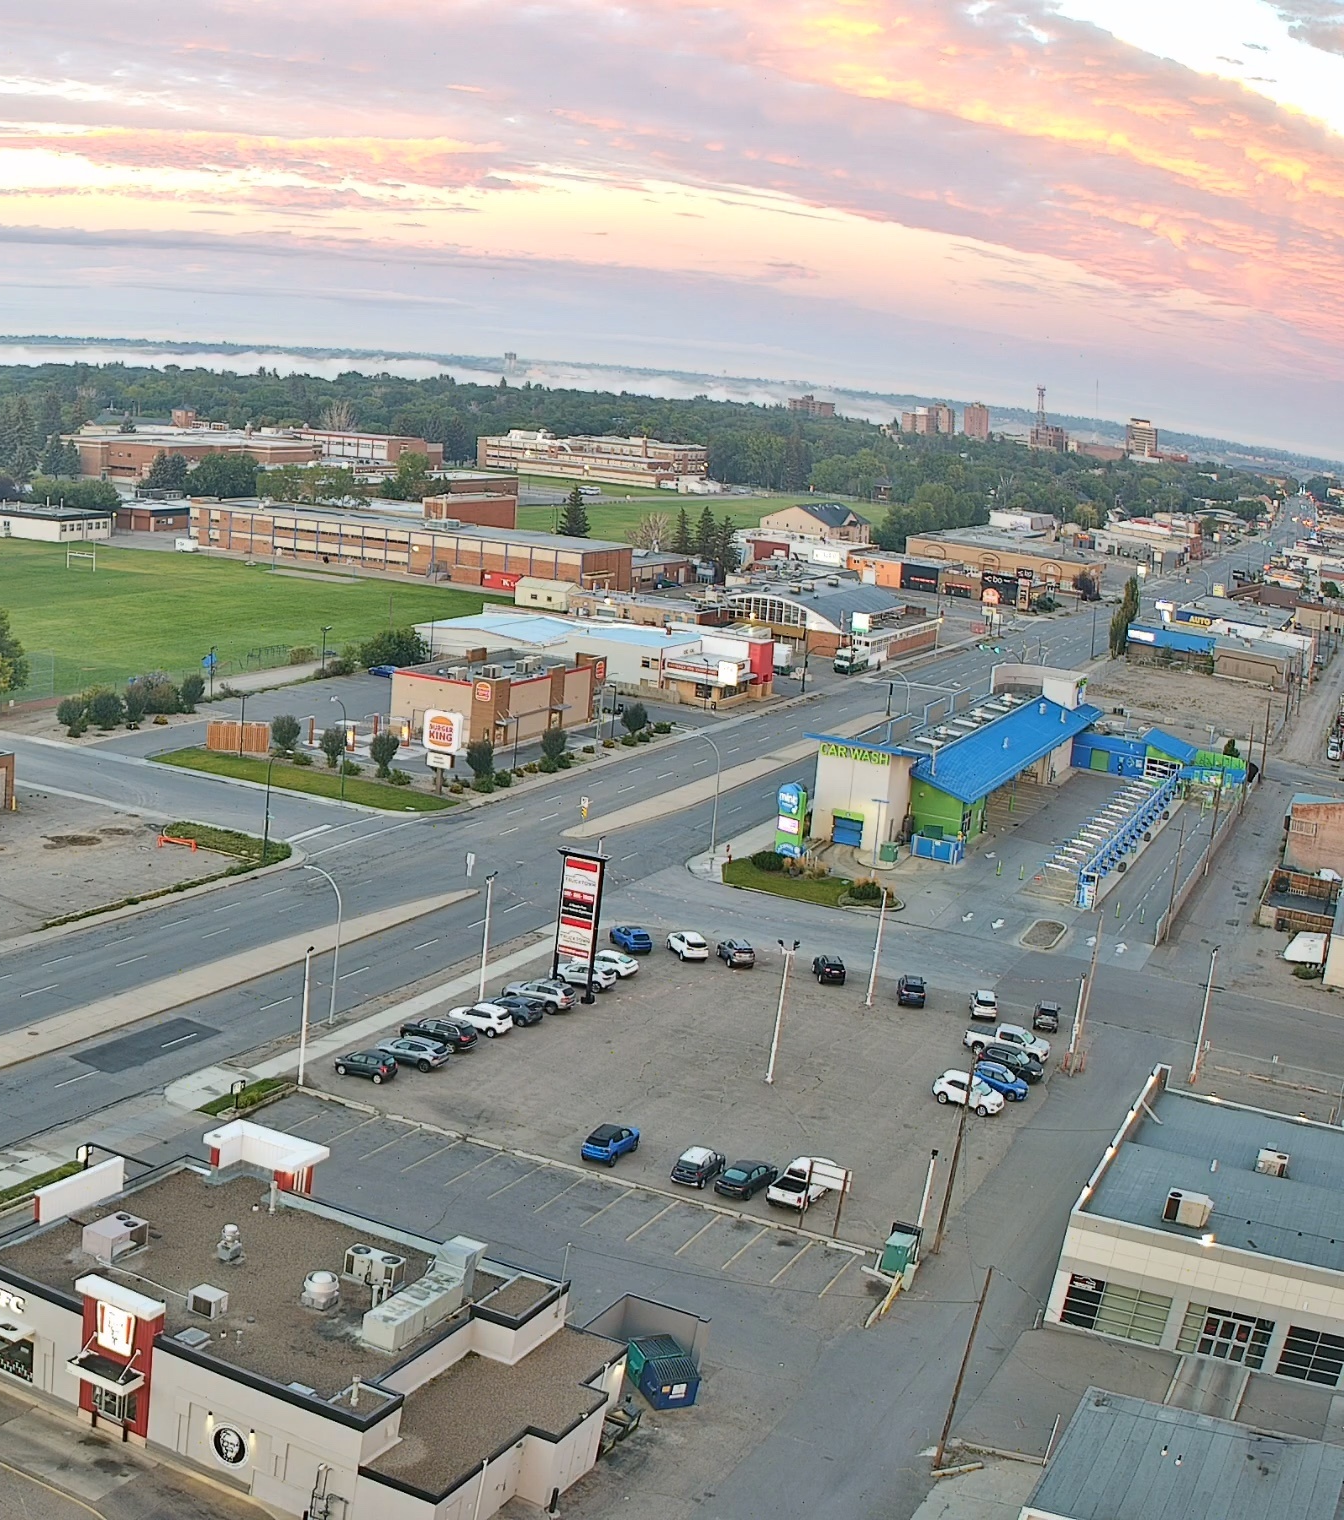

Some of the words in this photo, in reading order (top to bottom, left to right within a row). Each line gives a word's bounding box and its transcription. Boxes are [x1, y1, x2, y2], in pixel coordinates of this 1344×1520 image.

[1189, 615, 1212, 626] AUTO
[429, 722, 454, 734] BURGER
[428, 730, 453, 743] KING
[820, 742, 847, 759] CAR
[850, 748, 890, 766] WASH
